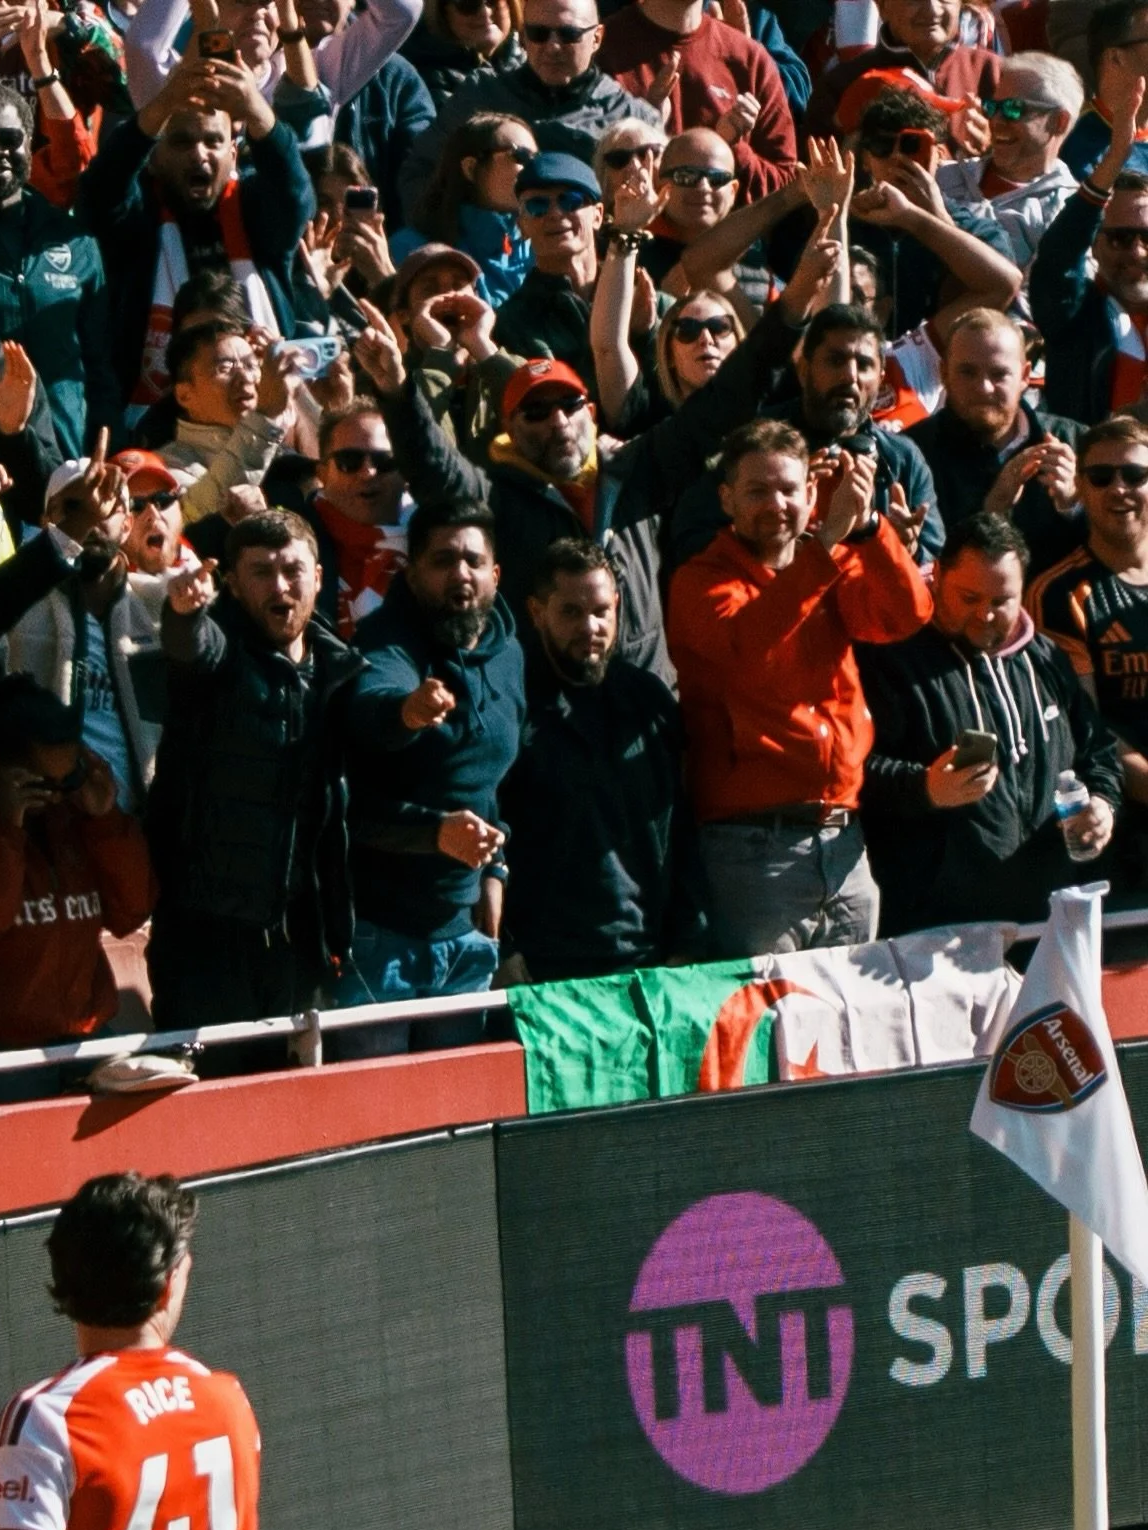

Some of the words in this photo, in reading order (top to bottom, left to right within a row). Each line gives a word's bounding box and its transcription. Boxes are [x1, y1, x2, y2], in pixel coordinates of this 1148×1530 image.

[1043, 1018, 1095, 1086] Arsenal
[888, 1252, 1148, 1388] SPO
[123, 1376, 195, 1426] RICE
